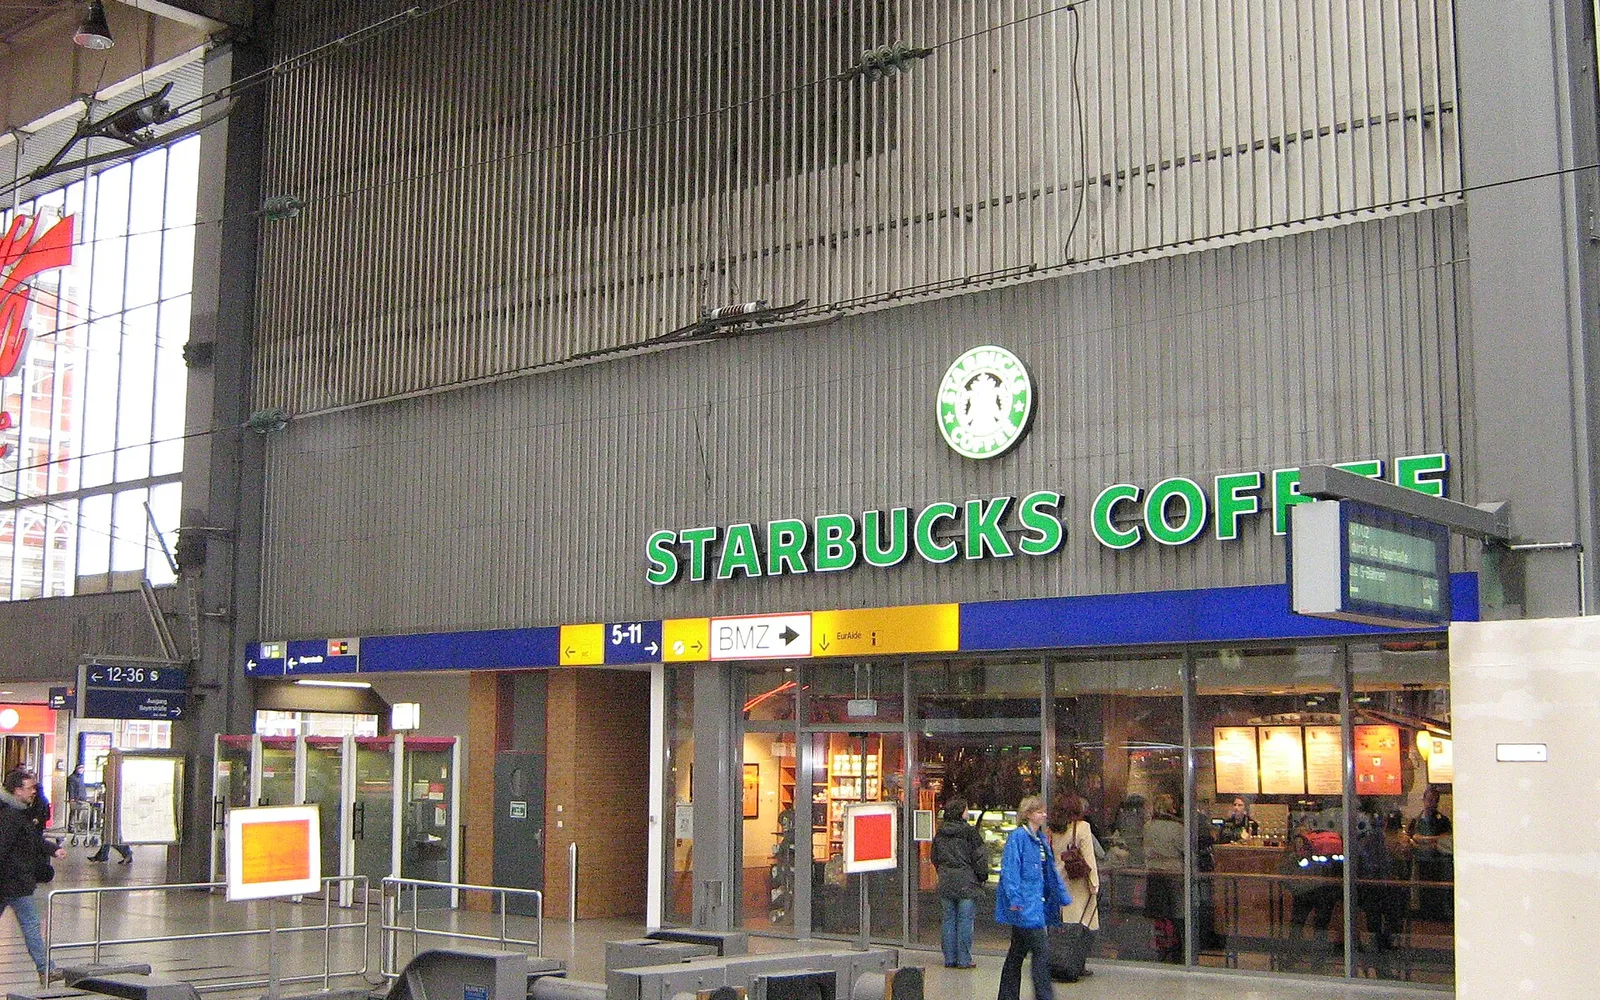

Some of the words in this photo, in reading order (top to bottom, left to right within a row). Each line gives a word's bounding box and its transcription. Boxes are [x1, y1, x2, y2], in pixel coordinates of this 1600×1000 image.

[646, 491, 1063, 586] STARBUCKS
[1091, 453, 1447, 550] COFFE
[611, 623, 642, 645] 5-11
[719, 624, 770, 651] BMZ
[836, 631, 862, 640] EurAide
[106, 666, 144, 682] 12-36
